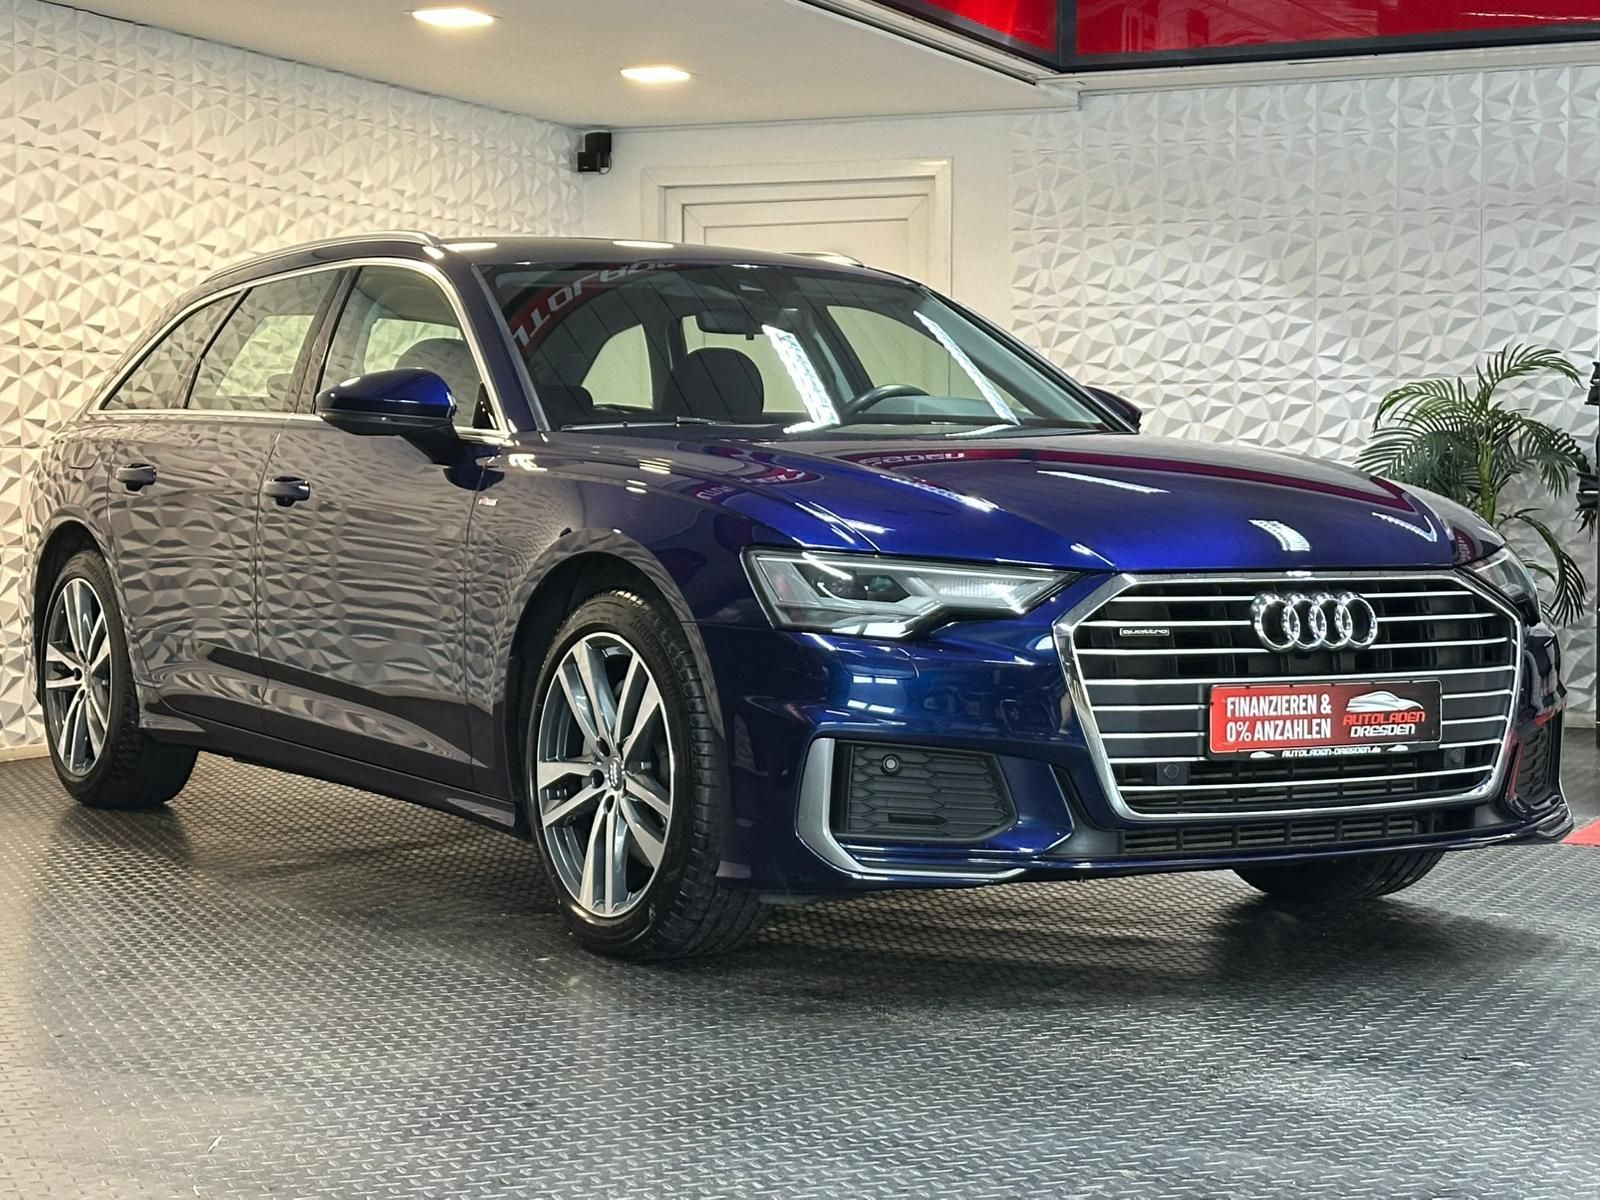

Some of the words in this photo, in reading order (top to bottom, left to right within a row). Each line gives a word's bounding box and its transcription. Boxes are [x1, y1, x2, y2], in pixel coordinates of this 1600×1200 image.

[1226, 695, 1317, 717] FINANZIEREN
[1320, 693, 1332, 714] &
[1343, 711, 1425, 725] AUTOLADEN
[1226, 721, 1251, 742] 0%
[1253, 718, 1331, 741] ANZAHLEN
[1350, 723, 1415, 737] DRESDEN
